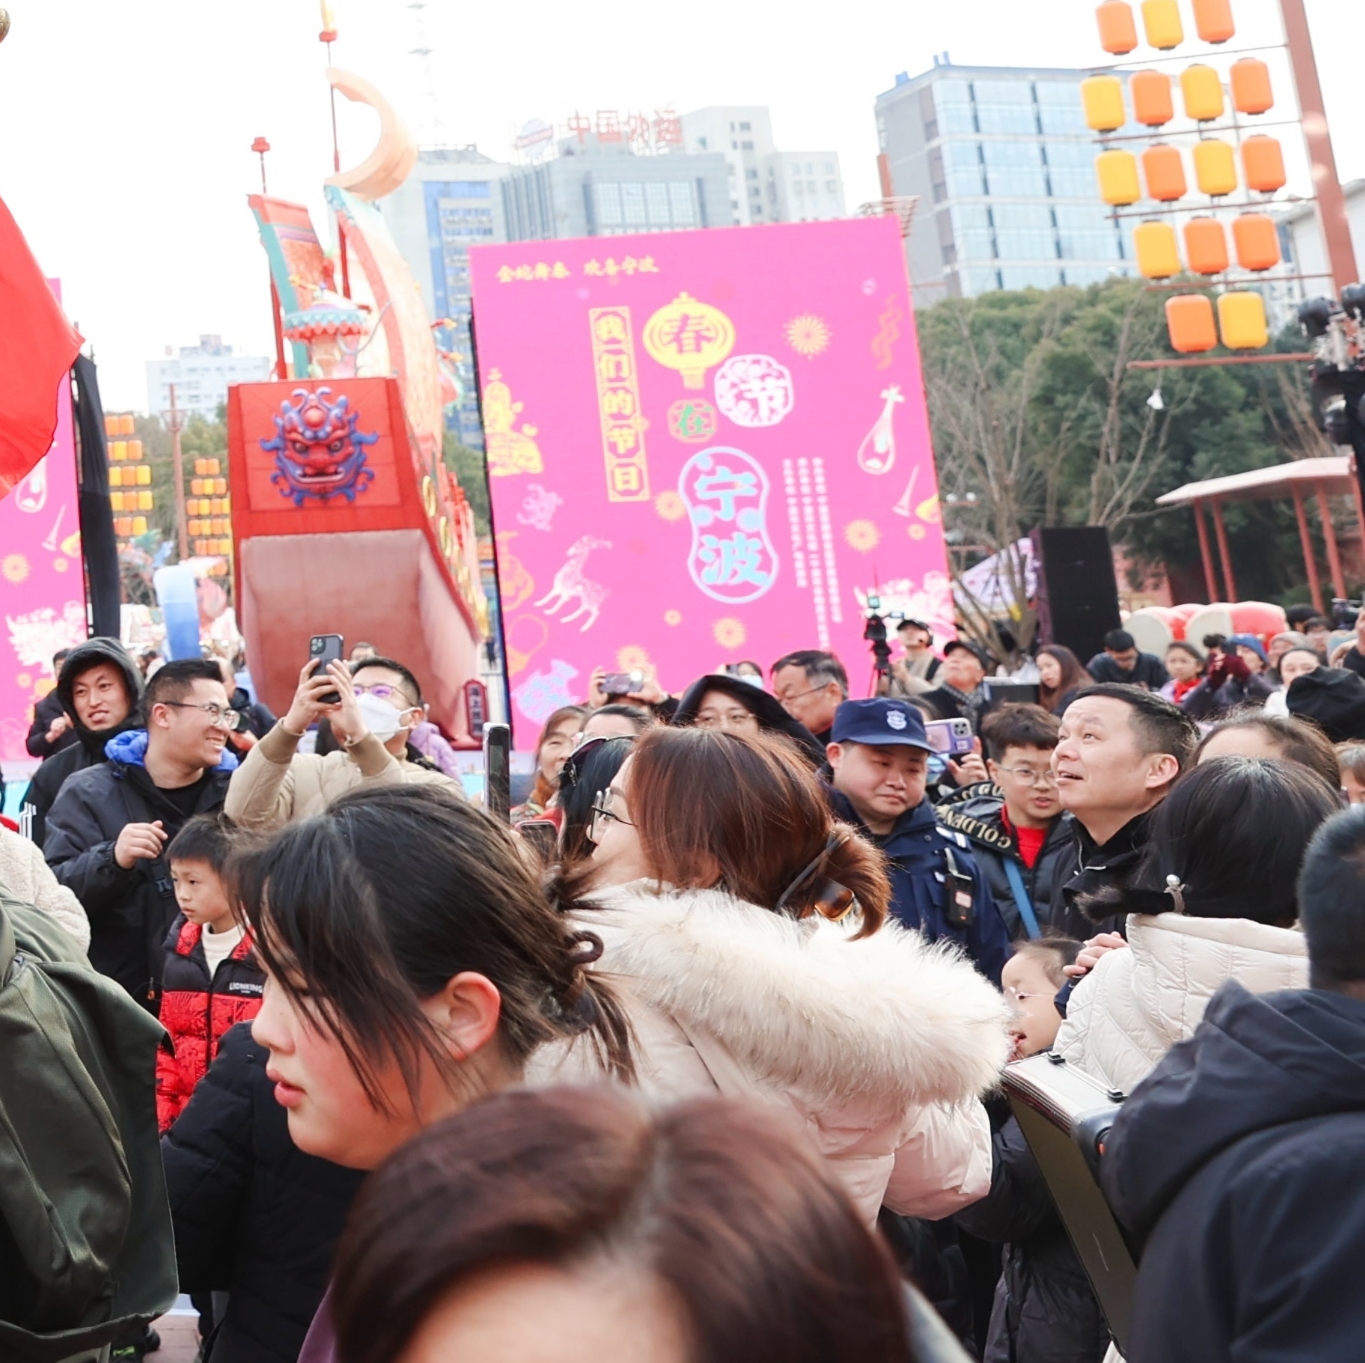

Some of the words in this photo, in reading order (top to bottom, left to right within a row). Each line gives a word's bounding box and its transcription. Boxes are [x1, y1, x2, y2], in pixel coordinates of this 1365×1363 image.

[594, 315, 638, 493] 我们的节日
[693, 465, 771, 588] 宁波
[945, 810, 1012, 848] GOLDEN
